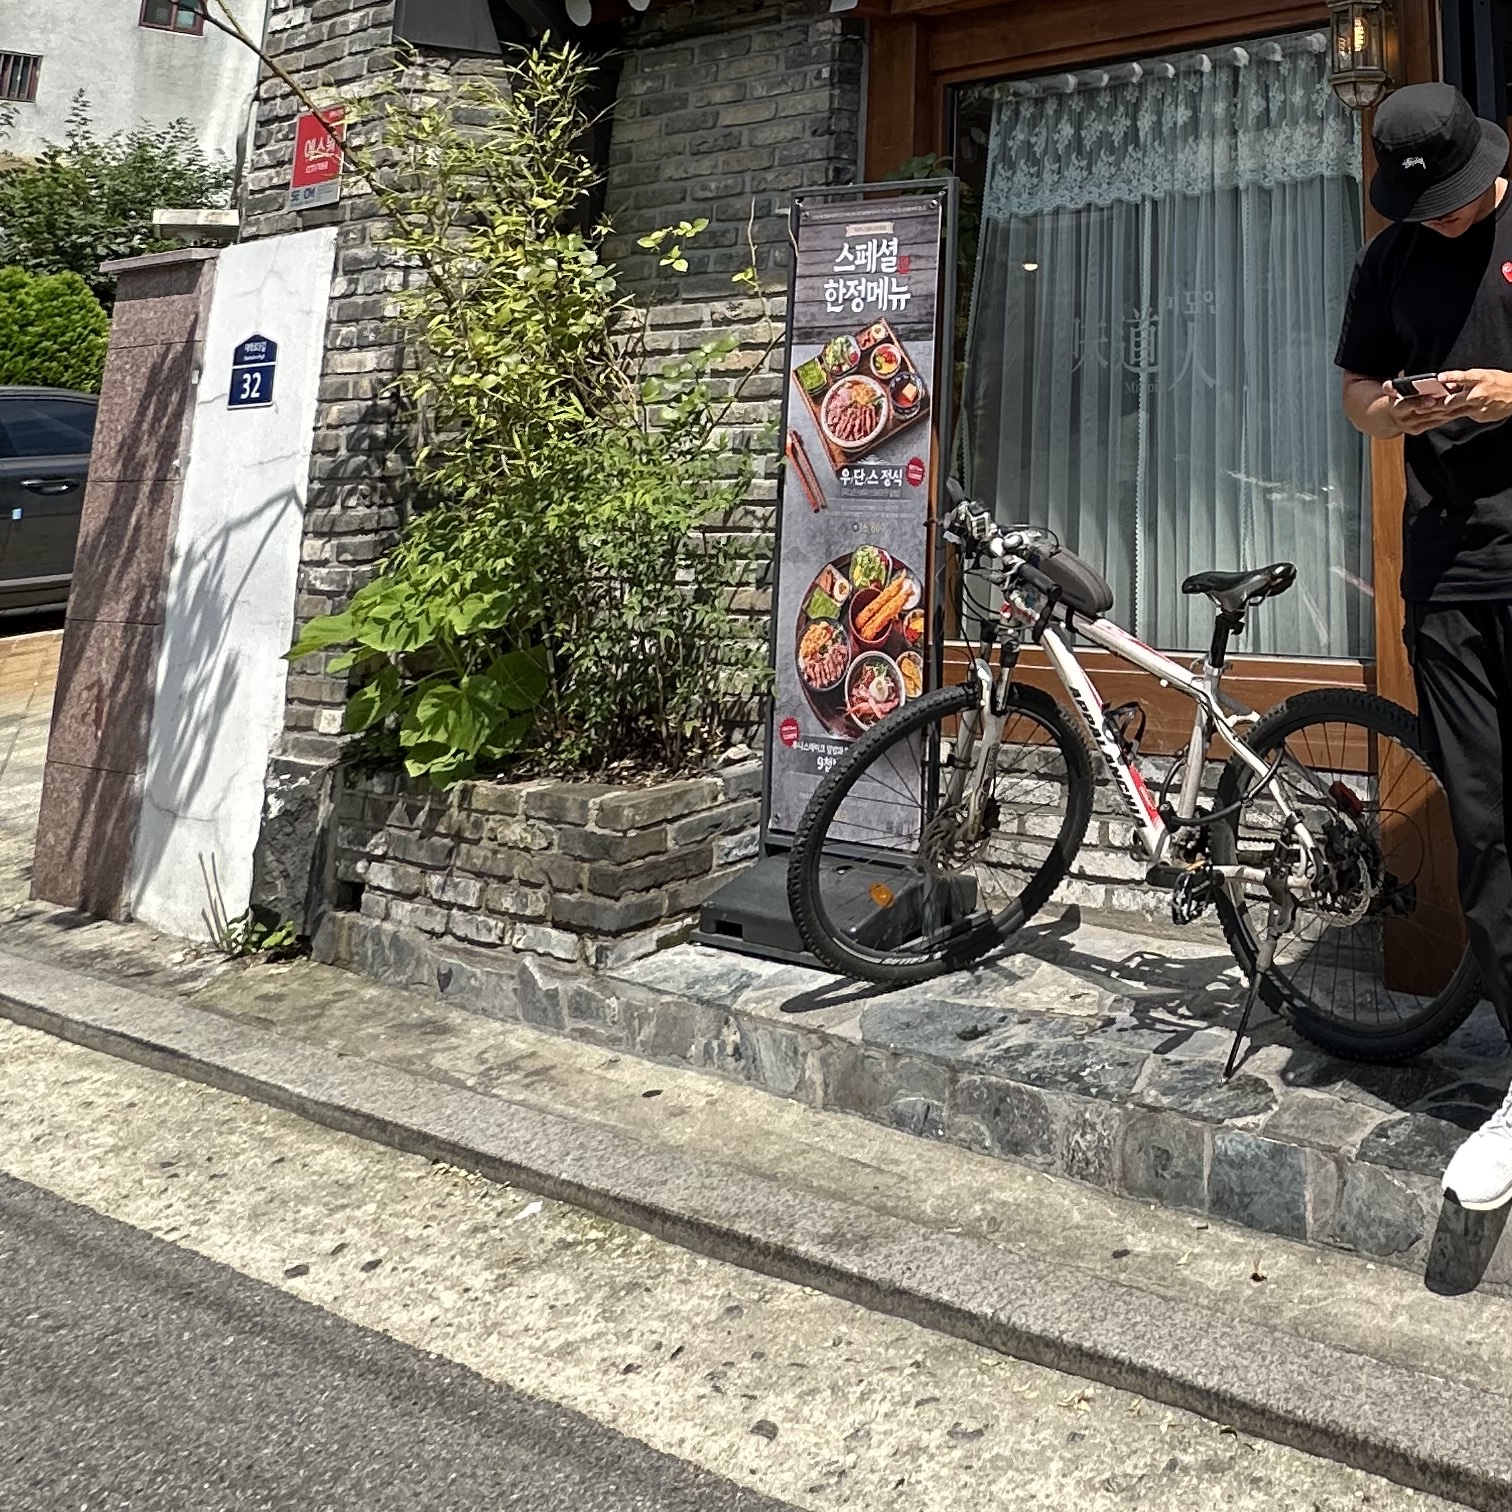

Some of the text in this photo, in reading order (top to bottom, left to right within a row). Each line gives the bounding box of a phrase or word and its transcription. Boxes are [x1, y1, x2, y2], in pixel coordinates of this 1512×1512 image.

[833, 237, 898, 274] 스페셜
[824, 276, 911, 313] 한정메뉴
[241, 372, 261, 399] 32
[1068, 686, 1147, 828] APPALANCHIA
